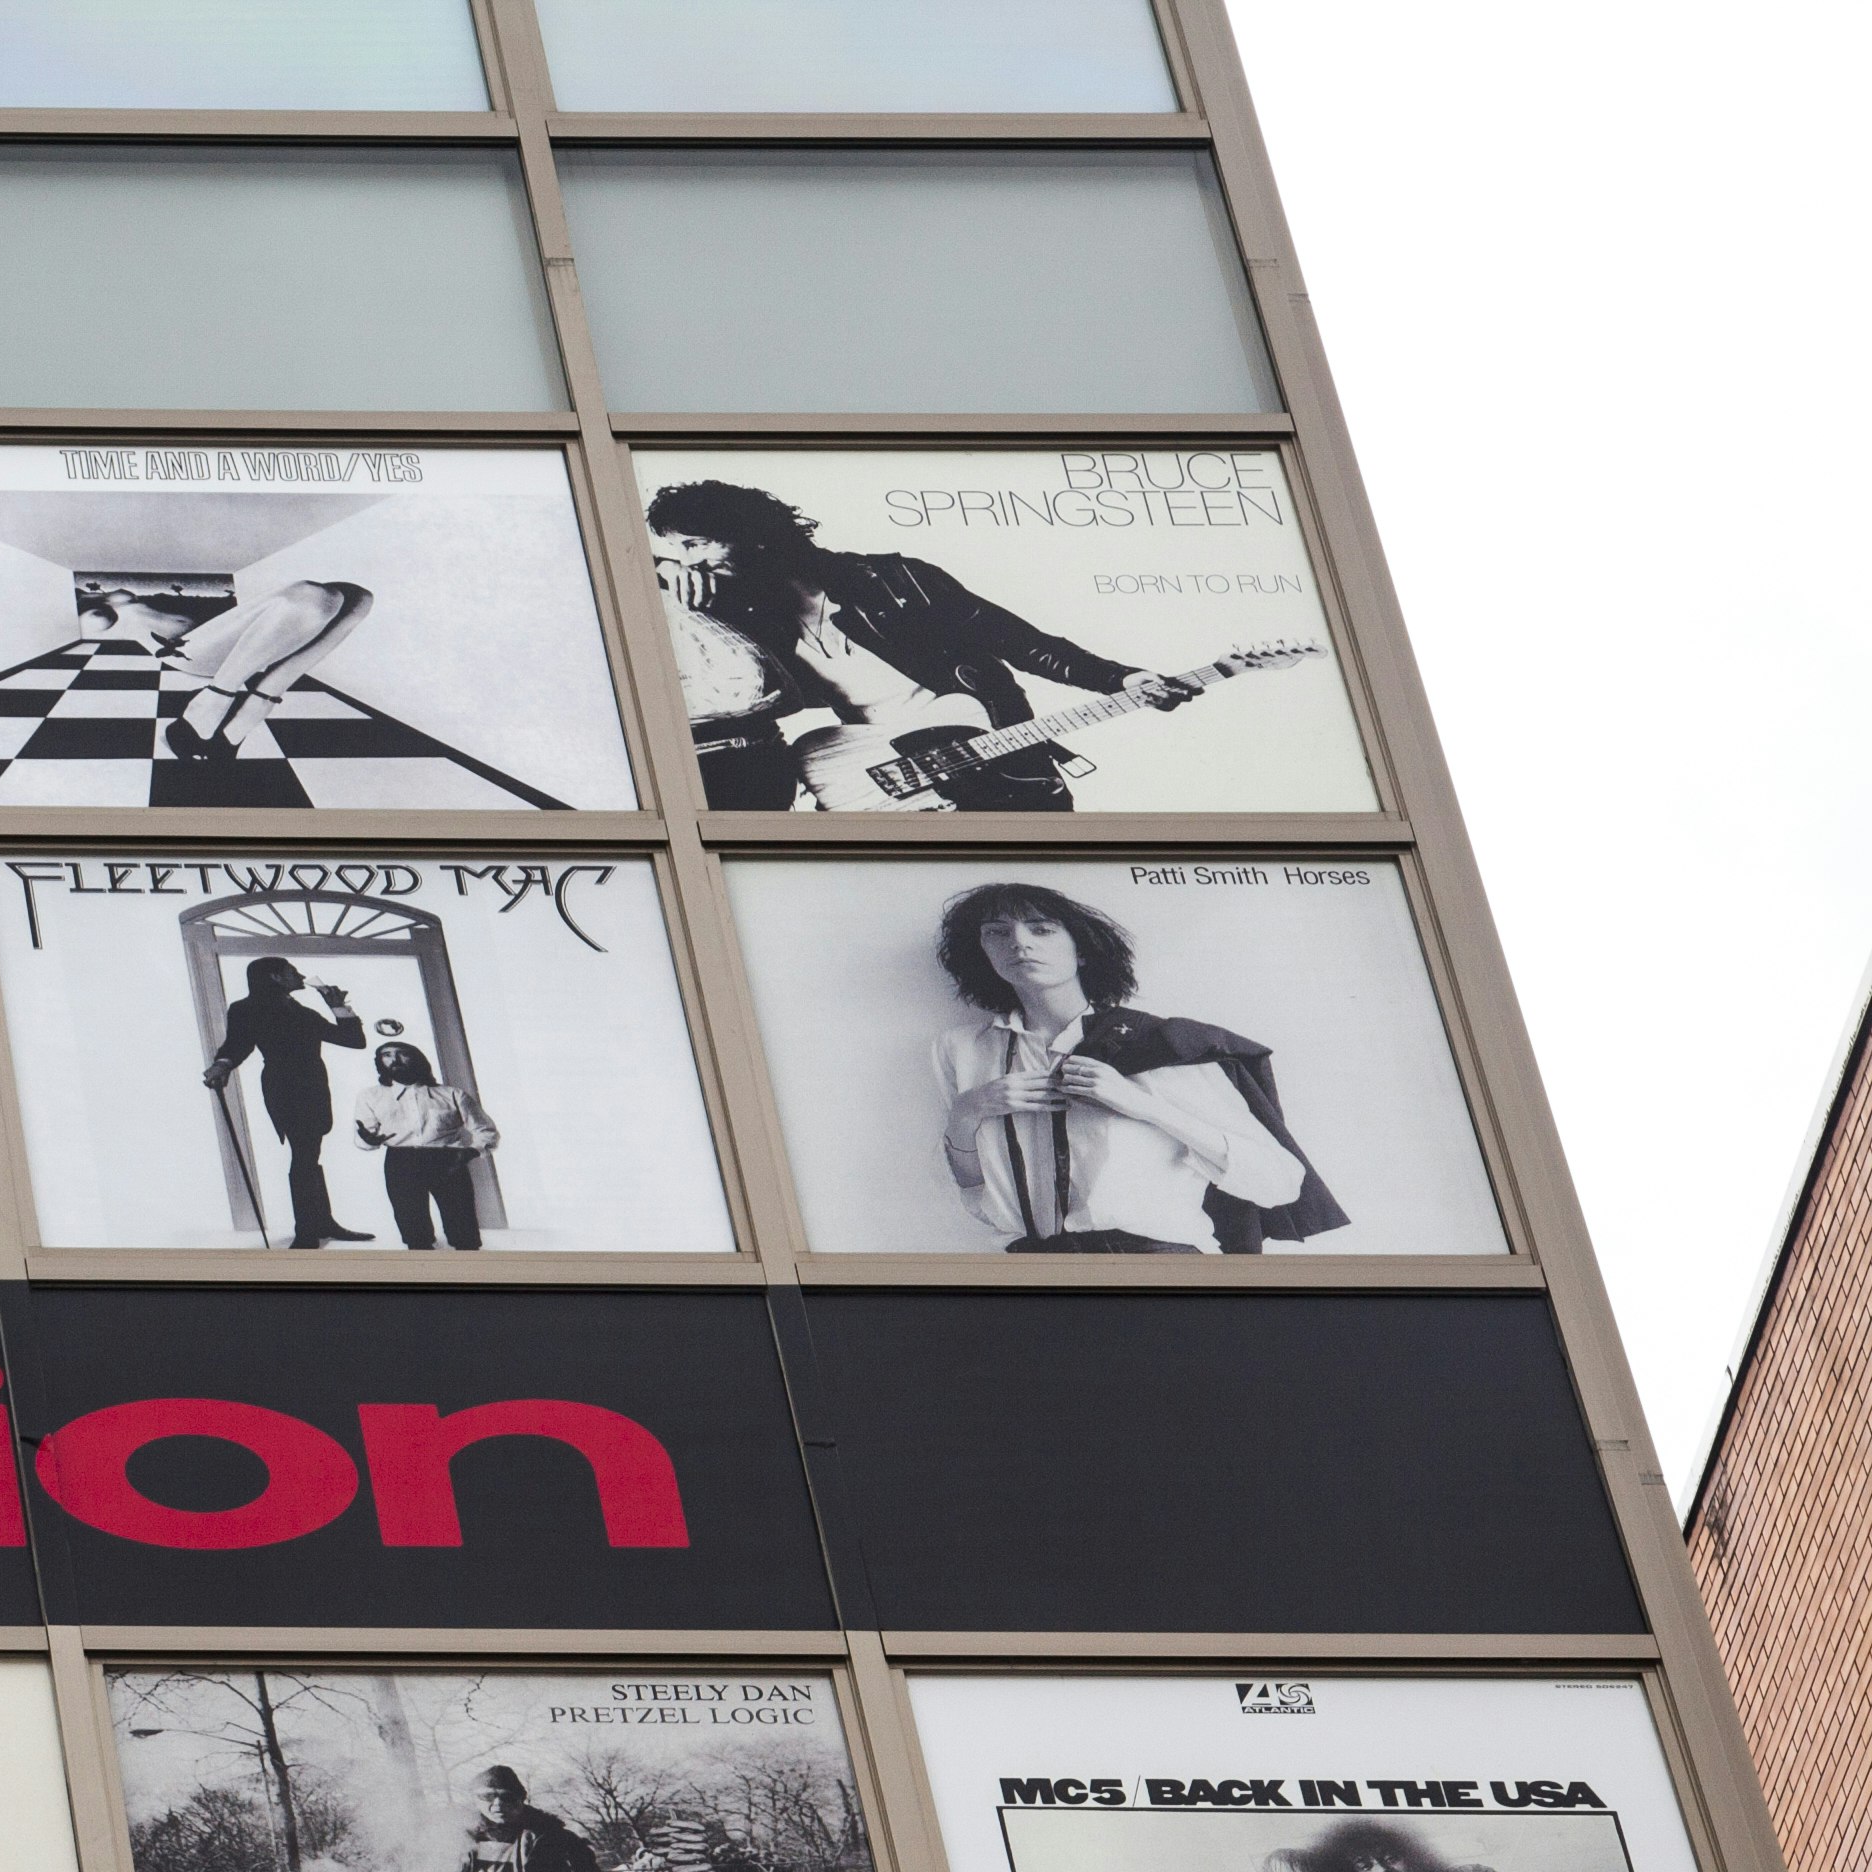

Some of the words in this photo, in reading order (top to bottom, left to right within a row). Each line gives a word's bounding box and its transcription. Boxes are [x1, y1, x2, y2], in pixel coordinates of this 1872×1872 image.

[59, 450, 140, 480] TIME
[146, 451, 211, 481] AND
[218, 451, 241, 481] A
[1062, 452, 1273, 490] BRUCE
[886, 490, 1283, 526] SPRINGSTEEN
[1093, 573, 1183, 594] BORN
[1187, 574, 1231, 594] TO
[1236, 574, 1304, 594] RUN
[1131, 867, 1186, 884] Patti
[1194, 867, 1268, 884] Smith
[1284, 867, 1370, 885] Horses
[5, 862, 423, 950] FLEETWOOD
[440, 864, 617, 952] MAC
[612, 1684, 728, 1701] STEELY
[742, 1685, 811, 1701] DAN
[551, 1707, 699, 1723] PRETZEL
[710, 1708, 816, 1724] LOGIC
[1243, 1706, 1315, 1714] ATLANTIC
[999, 1777, 1124, 1806] MC5
[1145, 1778, 1293, 1808] BACK
[1300, 1779, 1363, 1807] IN
[1365, 1780, 1483, 1808] THE
[1491, 1781, 1607, 1809] USA
